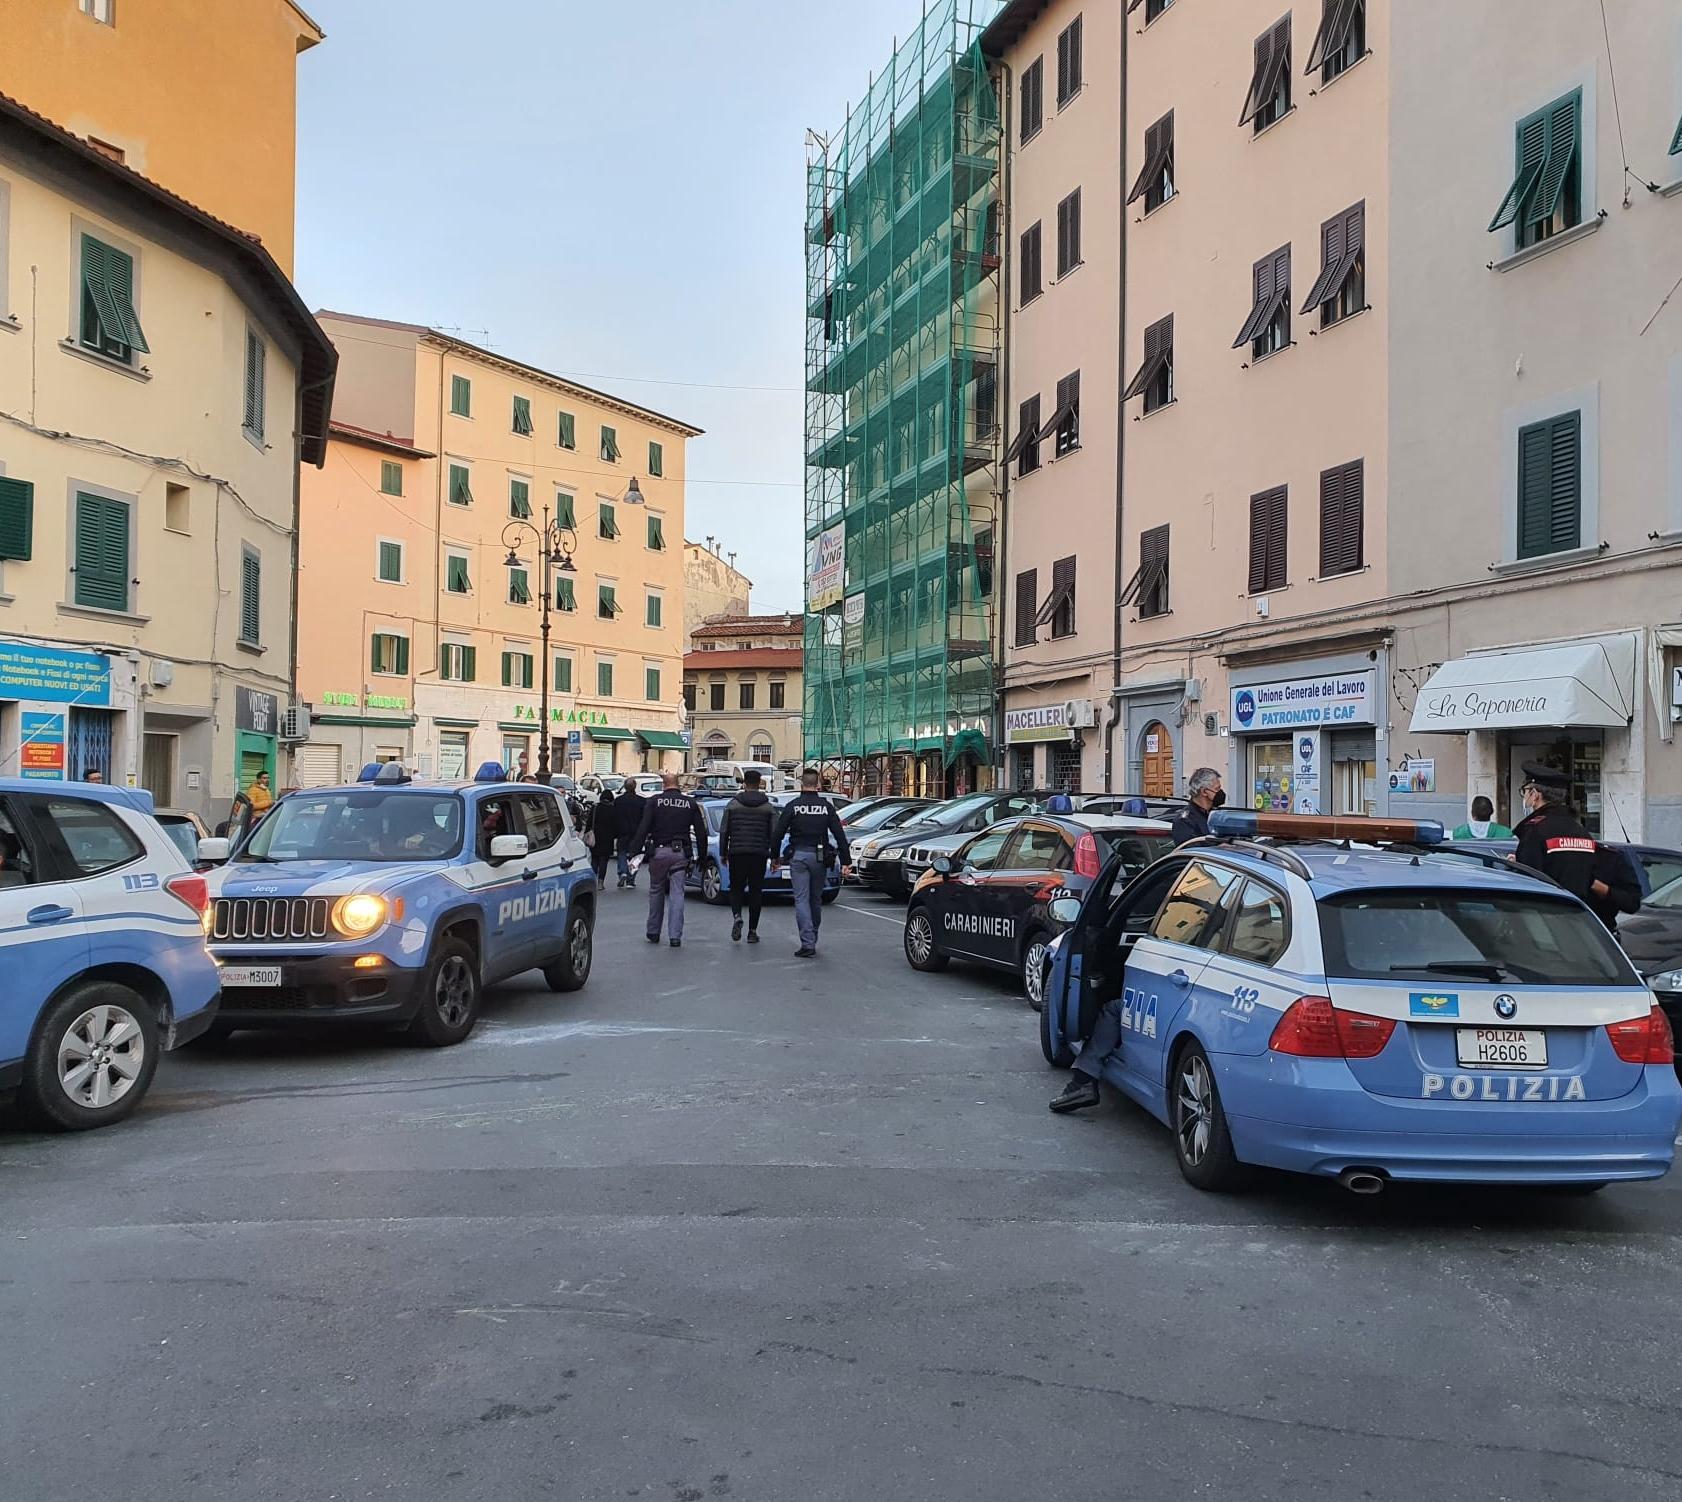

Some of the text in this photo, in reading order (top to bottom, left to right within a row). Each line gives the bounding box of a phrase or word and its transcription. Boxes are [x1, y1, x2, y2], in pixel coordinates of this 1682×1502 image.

[2, 664, 40, 675] Notebook
[36, 656, 68, 667] notebook
[0, 675, 42, 687] COMPUTER
[44, 679, 68, 690] NUOVI
[69, 681, 79, 690] ED
[1258, 679, 1365, 703] Unione Generale del Lavoro
[1238, 702, 1253, 713] UGL
[1427, 692, 1547, 721] La Saponeria
[1007, 708, 1065, 730] MACELLERI
[1261, 708, 1321, 725] PATRONATO
[1333, 705, 1356, 720] CAF
[570, 732, 578, 743] P
[657, 798, 690, 808] POLIZIA
[794, 805, 829, 815] POLIZIA
[122, 872, 159, 892] 113
[251, 886, 279, 894] Jeep
[498, 888, 566, 927] POLIZIA
[944, 912, 1015, 938] CARABINIERI
[249, 970, 280, 983] M3007
[1230, 985, 1259, 1013] 113
[1476, 1030, 1527, 1043] POLIZIA
[1478, 1044, 1528, 1062] H2606
[1422, 1073, 1587, 1101] POLIZIA
